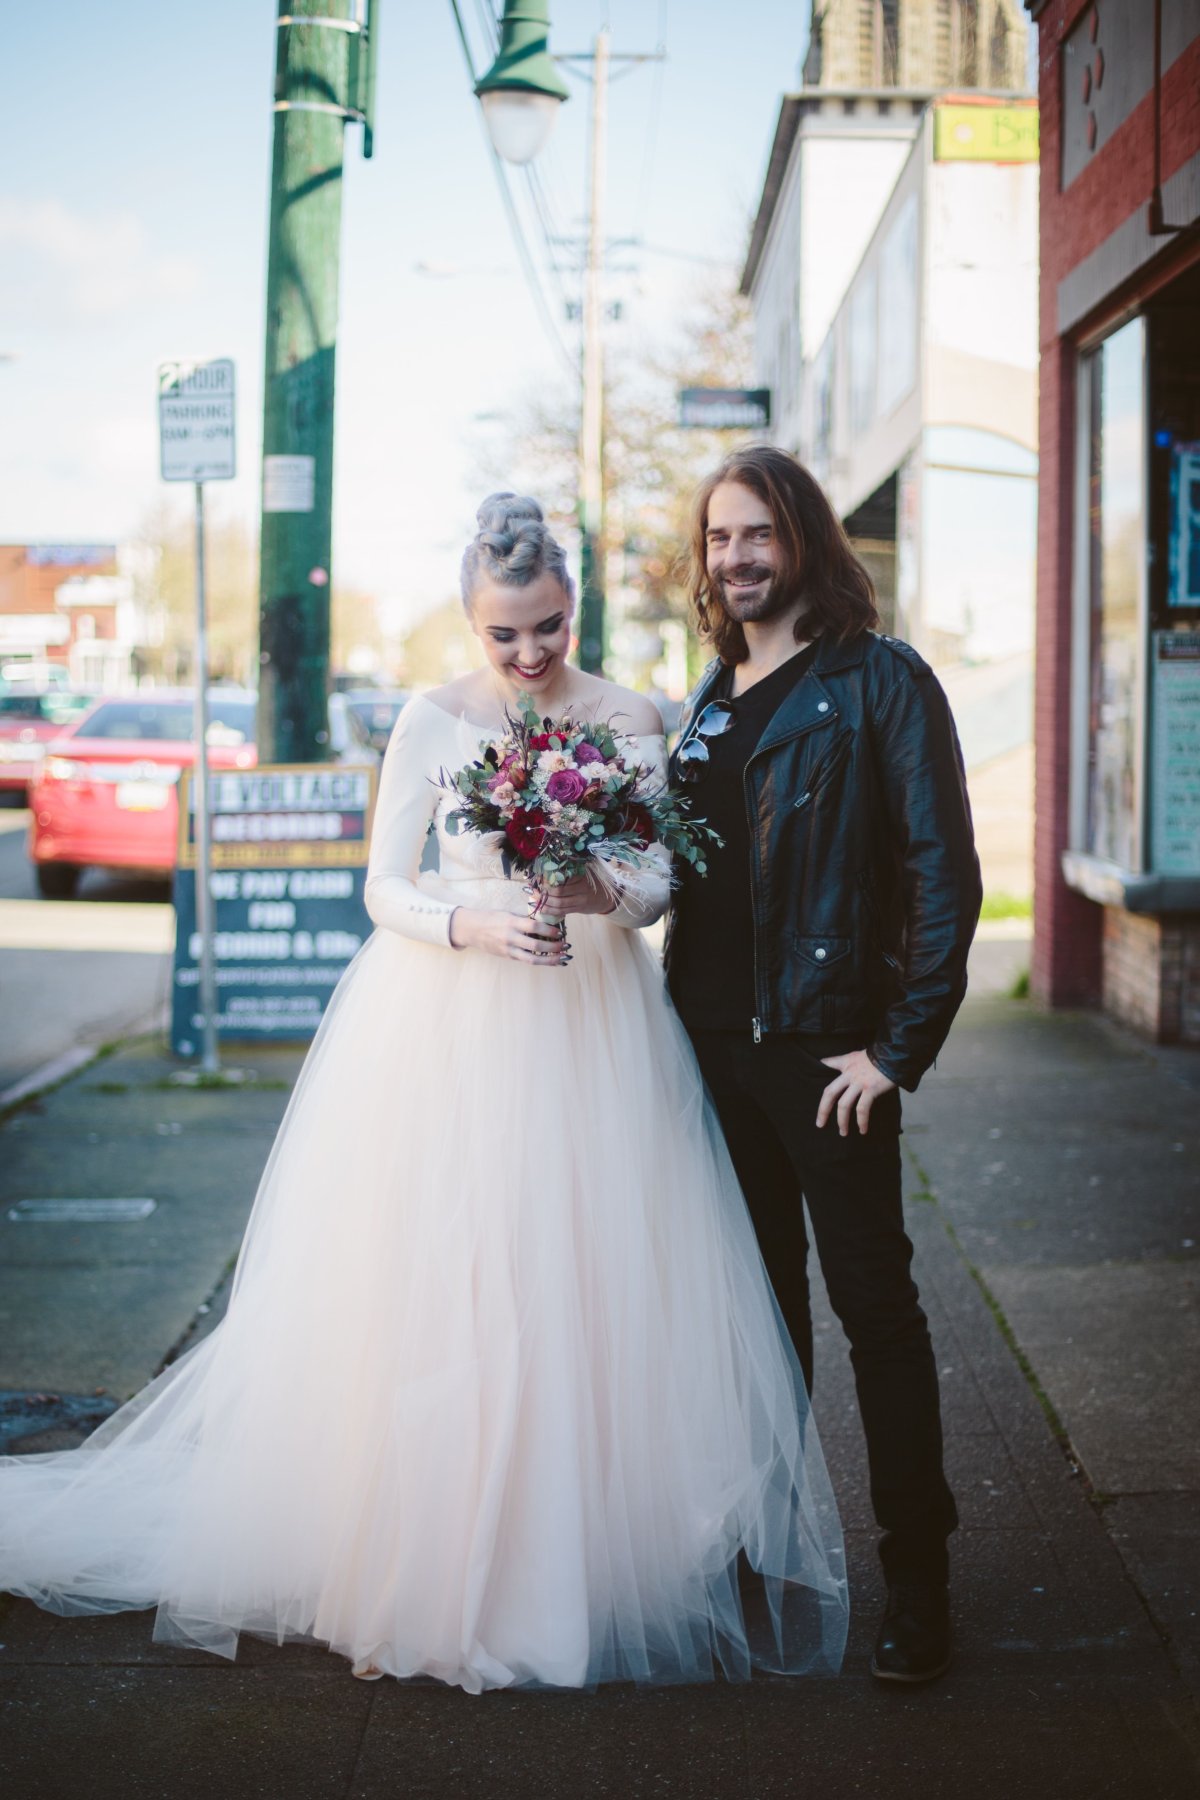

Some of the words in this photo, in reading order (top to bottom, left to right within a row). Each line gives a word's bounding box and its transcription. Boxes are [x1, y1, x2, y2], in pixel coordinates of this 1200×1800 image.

[165, 405, 228, 419] PARKING
[243, 871, 288, 899] PAY
[289, 871, 353, 899] CASH
[249, 902, 295, 929] FOR
[189, 932, 292, 960] RCORDS
